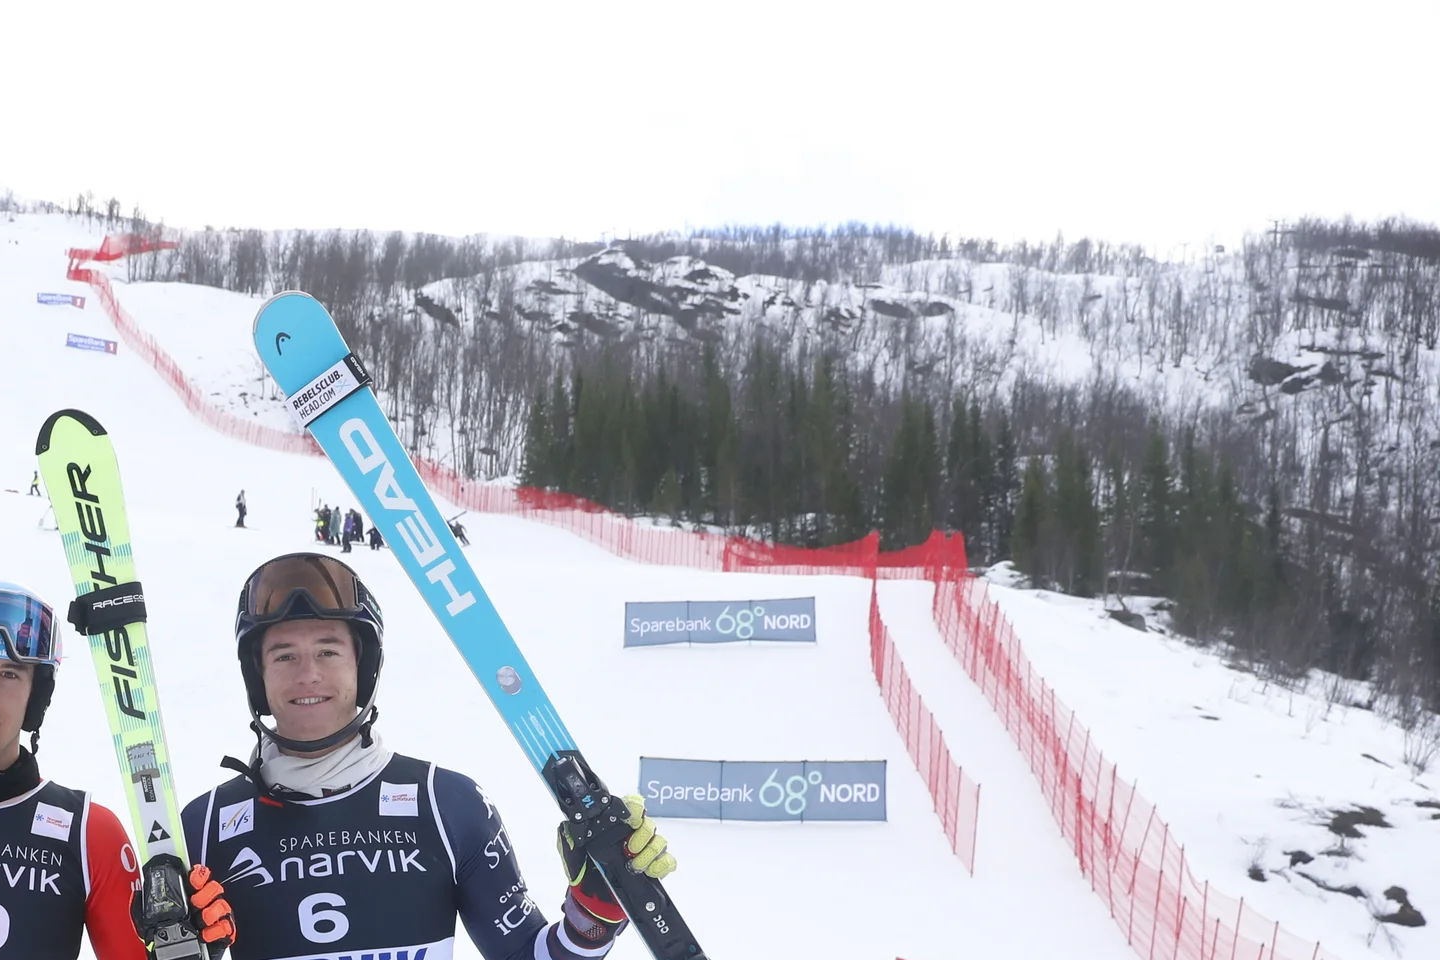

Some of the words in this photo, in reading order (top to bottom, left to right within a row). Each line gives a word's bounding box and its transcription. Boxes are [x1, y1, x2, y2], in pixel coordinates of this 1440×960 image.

[293, 371, 343, 410] REBELSCLUB.
[299, 388, 336, 420] HEAD.COM
[339, 418, 476, 616] HEAD
[66, 462, 146, 720] FISHER
[630, 617, 711, 636] Sparebank
[716, 606, 765, 639] 68°
[763, 614, 811, 630] NORD
[647, 781, 753, 803] Sparebank
[759, 769, 822, 815] 68°
[820, 784, 880, 803] NORD
[279, 830, 418, 852] SPAREBANKEN
[280, 849, 428, 882] narvik
[298, 892, 350, 943] 6
